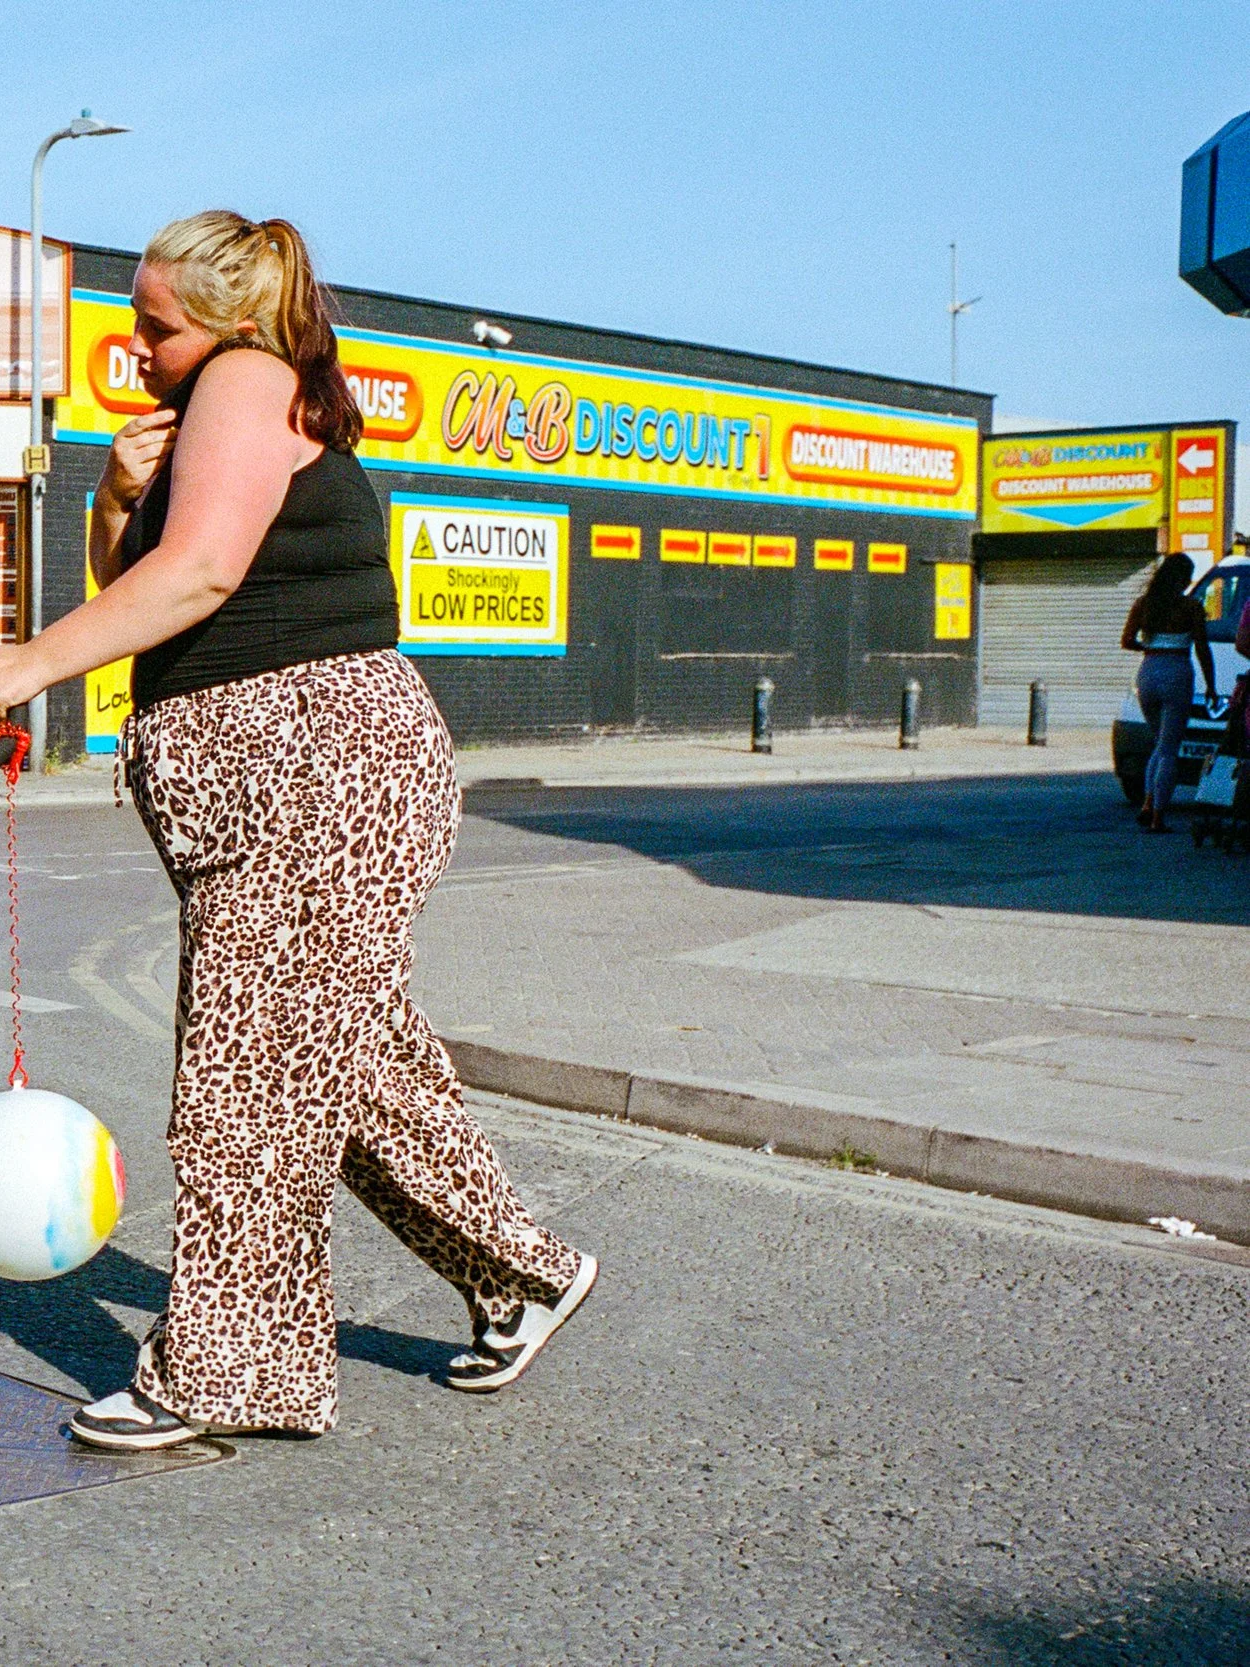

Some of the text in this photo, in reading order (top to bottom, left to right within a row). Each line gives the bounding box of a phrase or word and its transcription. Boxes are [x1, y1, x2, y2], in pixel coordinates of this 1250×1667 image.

[574, 397, 751, 471] DISCOUNT
[29, 448, 46, 470] H
[791, 431, 956, 481] DISCOUNT WAREHOUSE
[1052, 441, 1149, 464] DISCOUNT
[443, 522, 546, 558] CAUTION
[447, 567, 520, 594] Shockingly
[418, 592, 545, 622] LOW PRICES
